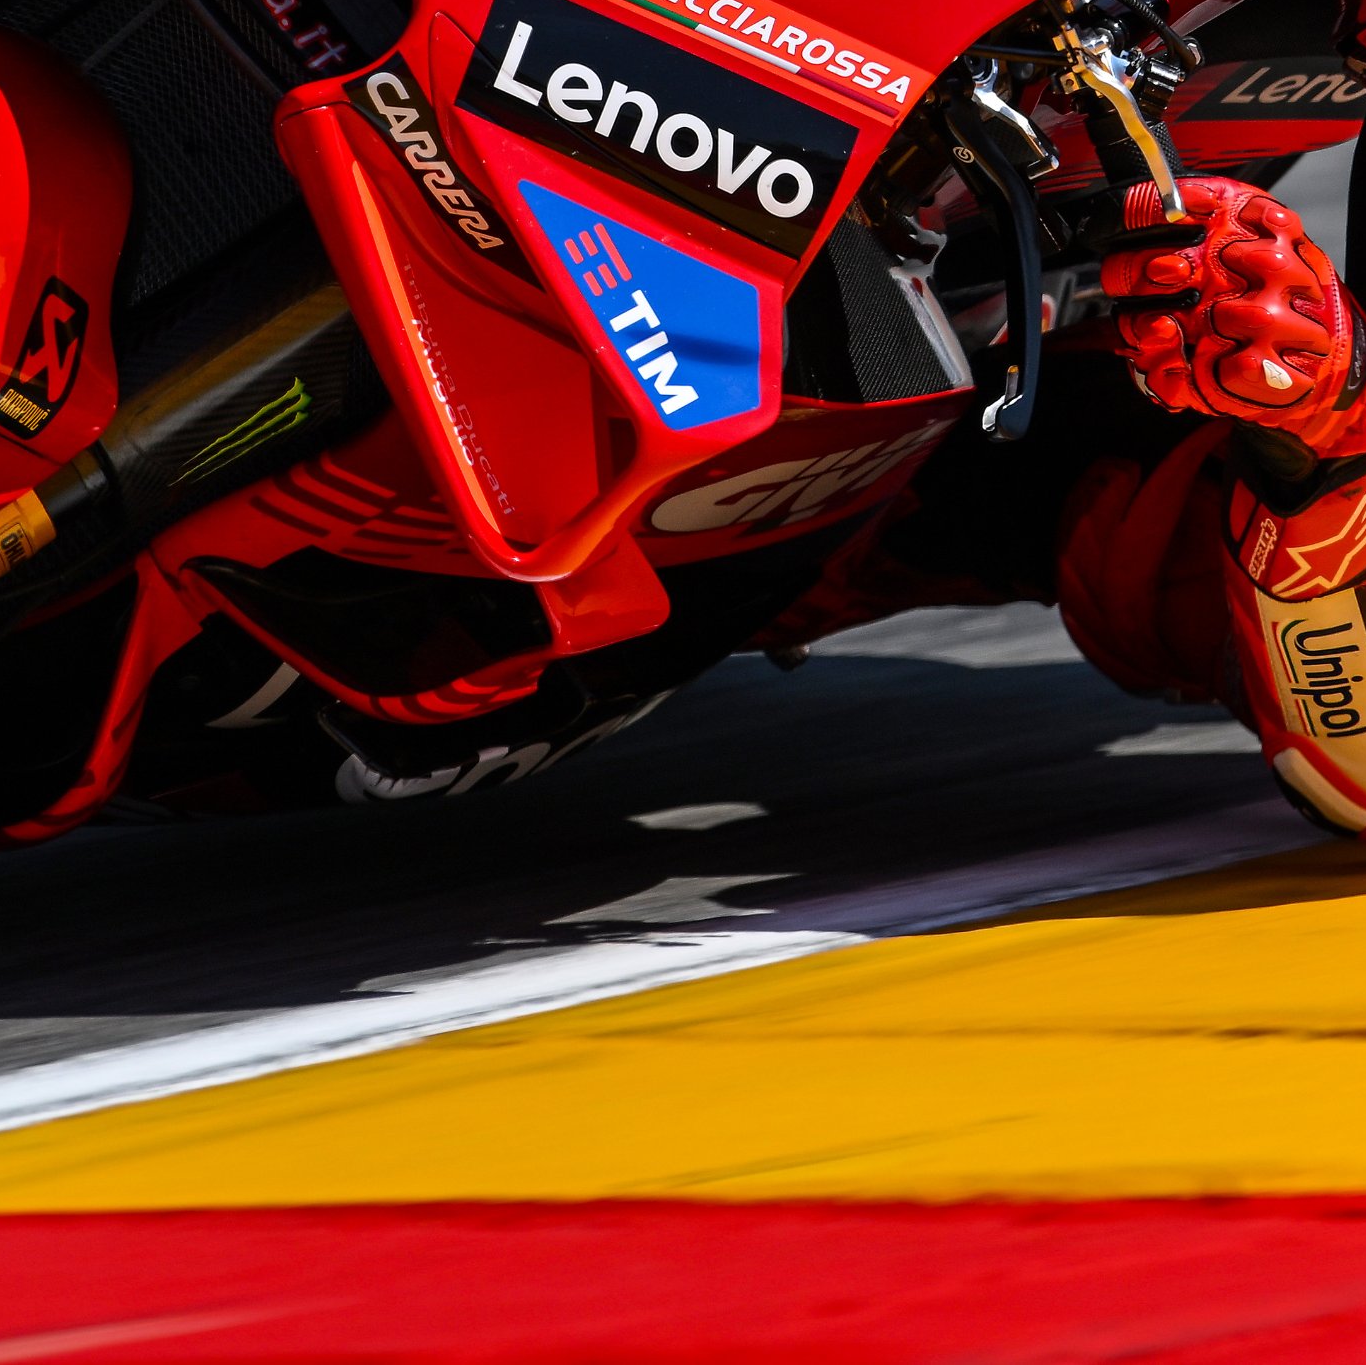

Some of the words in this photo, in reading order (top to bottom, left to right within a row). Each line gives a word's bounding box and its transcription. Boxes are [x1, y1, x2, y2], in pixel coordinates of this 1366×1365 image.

[366, 72, 504, 249] CARRERA
[494, 20, 814, 218] Lenovo
[609, 289, 699, 414] TIM
[457, 404, 516, 515] Ducati
